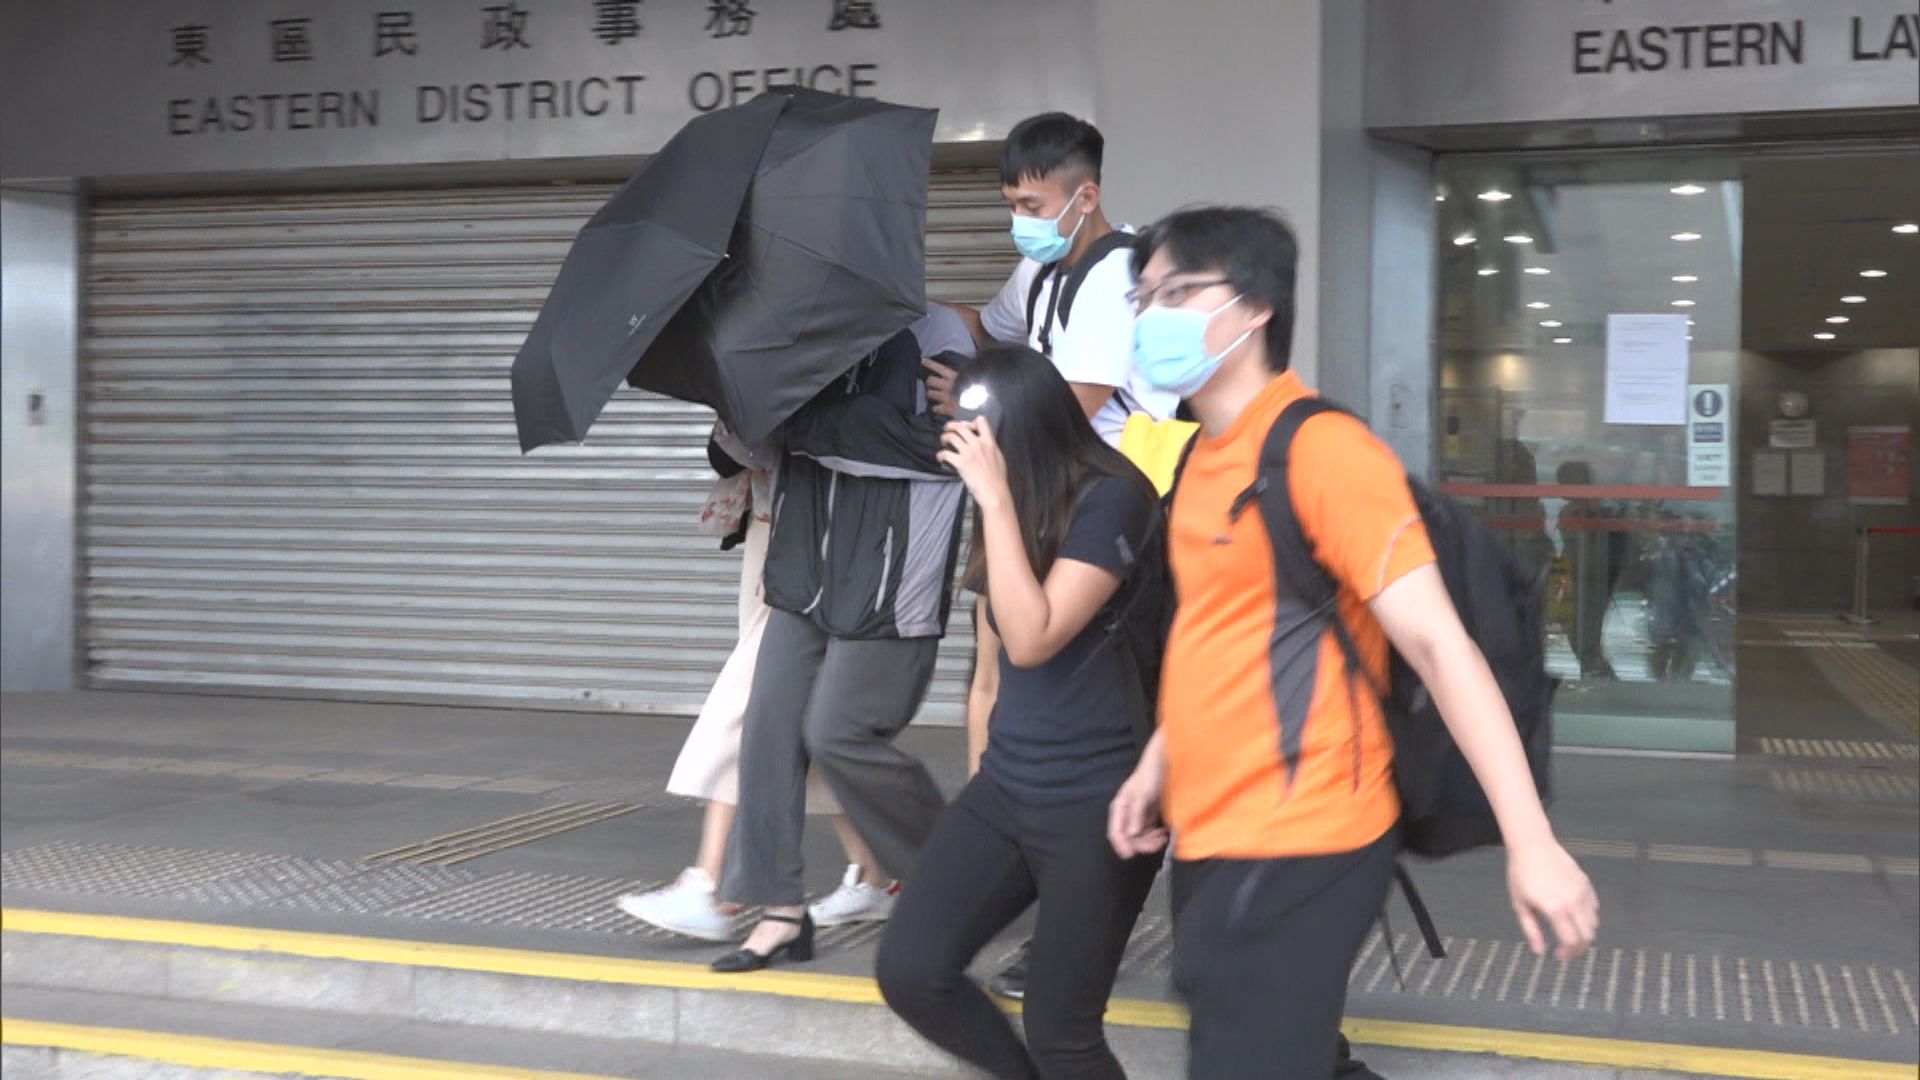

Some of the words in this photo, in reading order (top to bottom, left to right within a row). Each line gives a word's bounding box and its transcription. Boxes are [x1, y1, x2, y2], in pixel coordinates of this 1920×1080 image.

[1572, 19, 1804, 74] EASTERN
[1850, 14, 1920, 61] LA
[168, 89, 380, 135] EASTERN
[417, 75, 647, 123] DISTRICT
